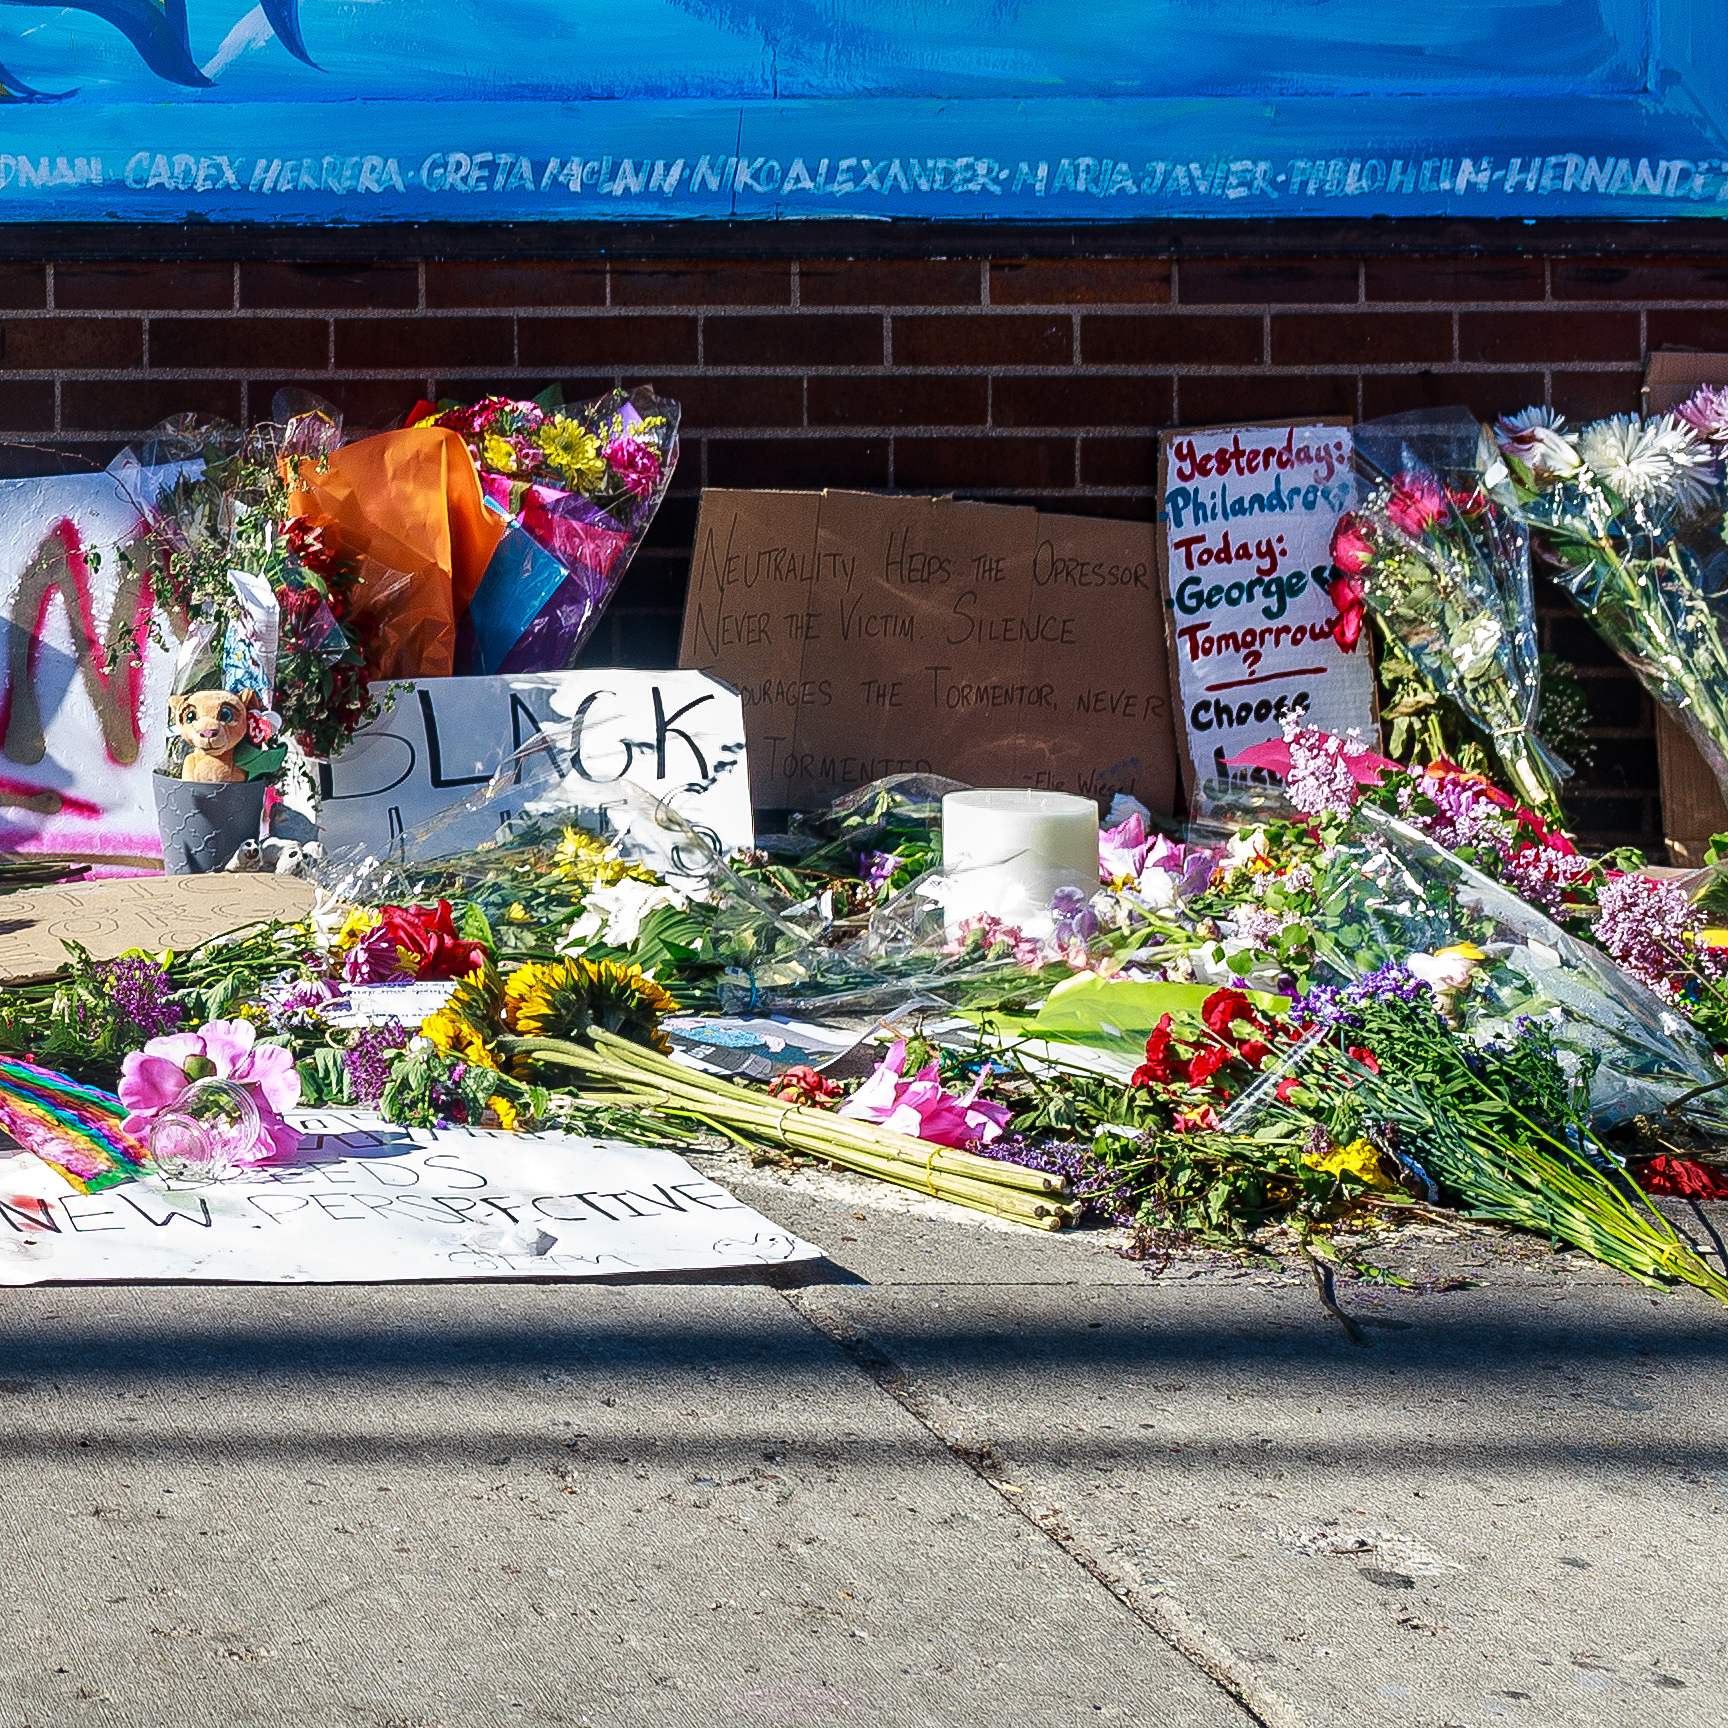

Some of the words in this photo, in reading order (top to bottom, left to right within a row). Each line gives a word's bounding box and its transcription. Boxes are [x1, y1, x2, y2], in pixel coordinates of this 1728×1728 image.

[123, 151, 242, 193] CADEX
[420, 151, 535, 193] GRETA
[1172, 426, 1346, 486] Yesterday:
[698, 512, 856, 593] NEUTRALITY
[885, 526, 952, 585] HELPS
[971, 554, 1007, 584] THE
[1033, 538, 1151, 589] OPRESSOR
[1173, 529, 1288, 578] Today:
[1175, 570, 1309, 621] George
[693, 589, 776, 657] NEVER
[783, 611, 823, 643] THE
[946, 589, 1078, 646] SILENCE
[860, 679, 905, 710] THE
[1076, 686, 1166, 722] NEVER
[246, 1181, 746, 1226] PERSPECTIVE
